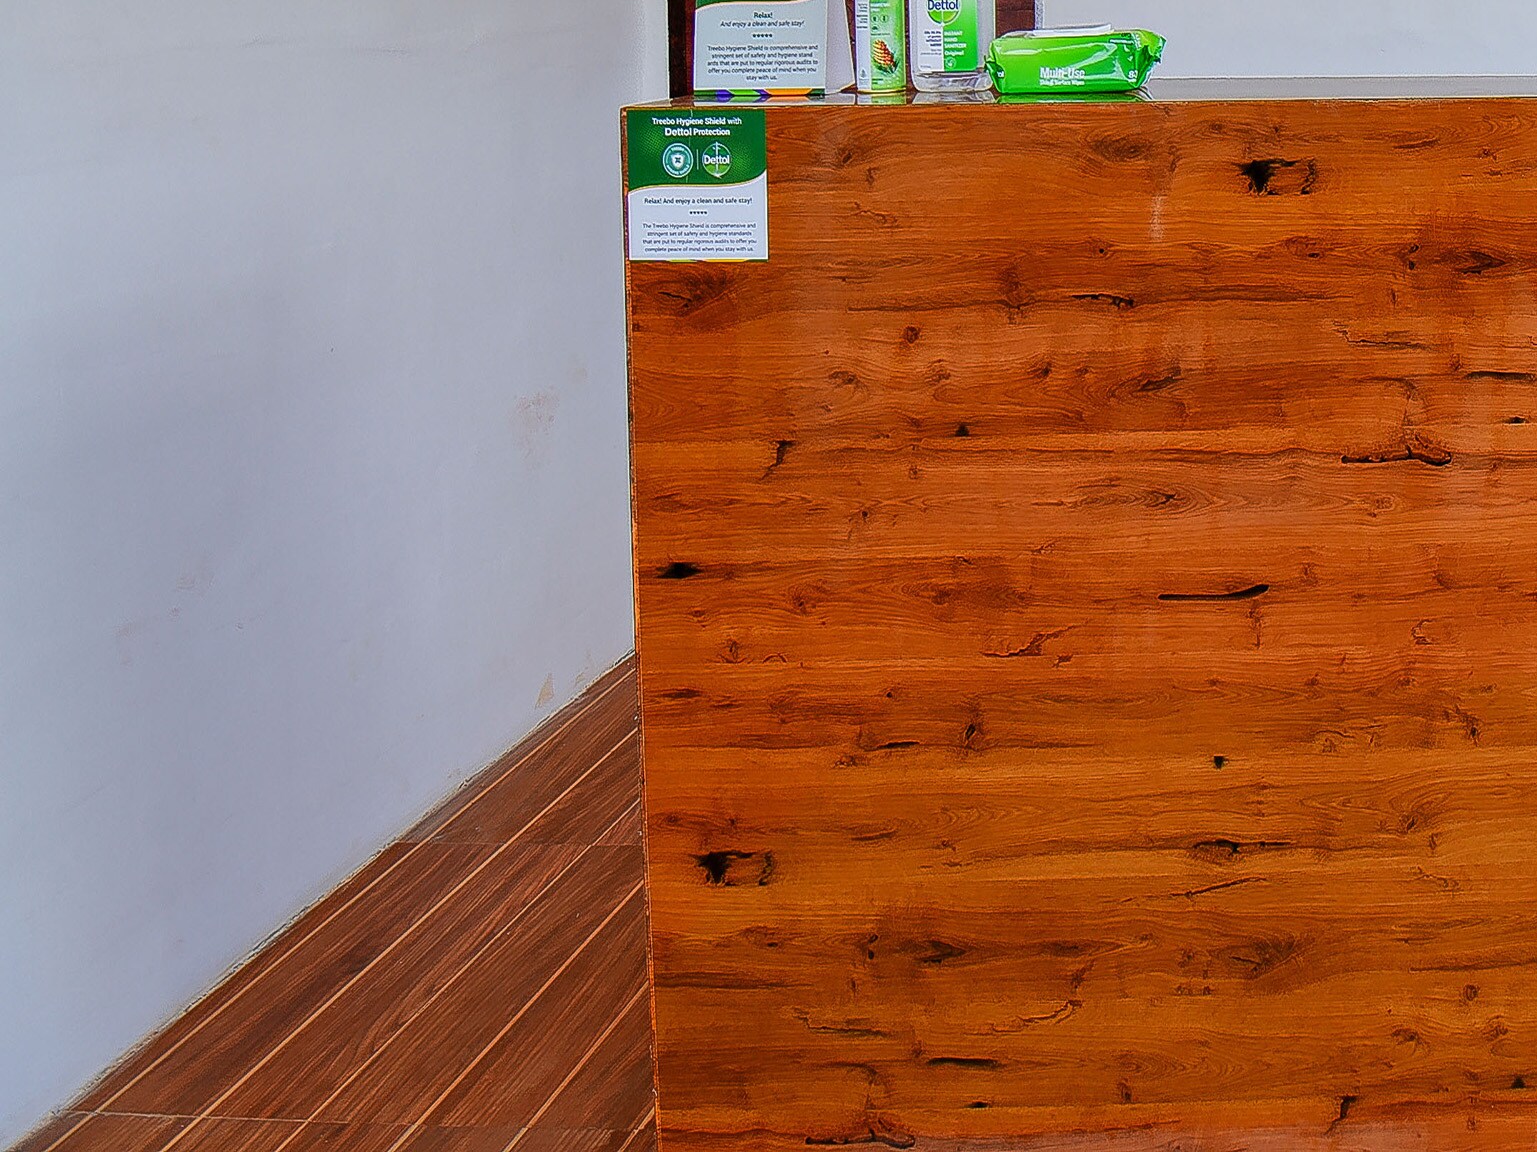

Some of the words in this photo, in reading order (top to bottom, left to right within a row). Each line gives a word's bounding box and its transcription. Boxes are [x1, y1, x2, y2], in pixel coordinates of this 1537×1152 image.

[928, 0, 959, 10] Dettol
[791, 20, 805, 28] stay!
[1040, 67, 1085, 79] Multi-Use
[652, 117, 675, 125] Treebo
[676, 117, 704, 126] Hygiene
[704, 117, 726, 125] Shield
[727, 117, 743, 125] with
[665, 128, 692, 136] Dettol
[693, 127, 730, 136] Protection
[704, 155, 730, 164] Dettol
